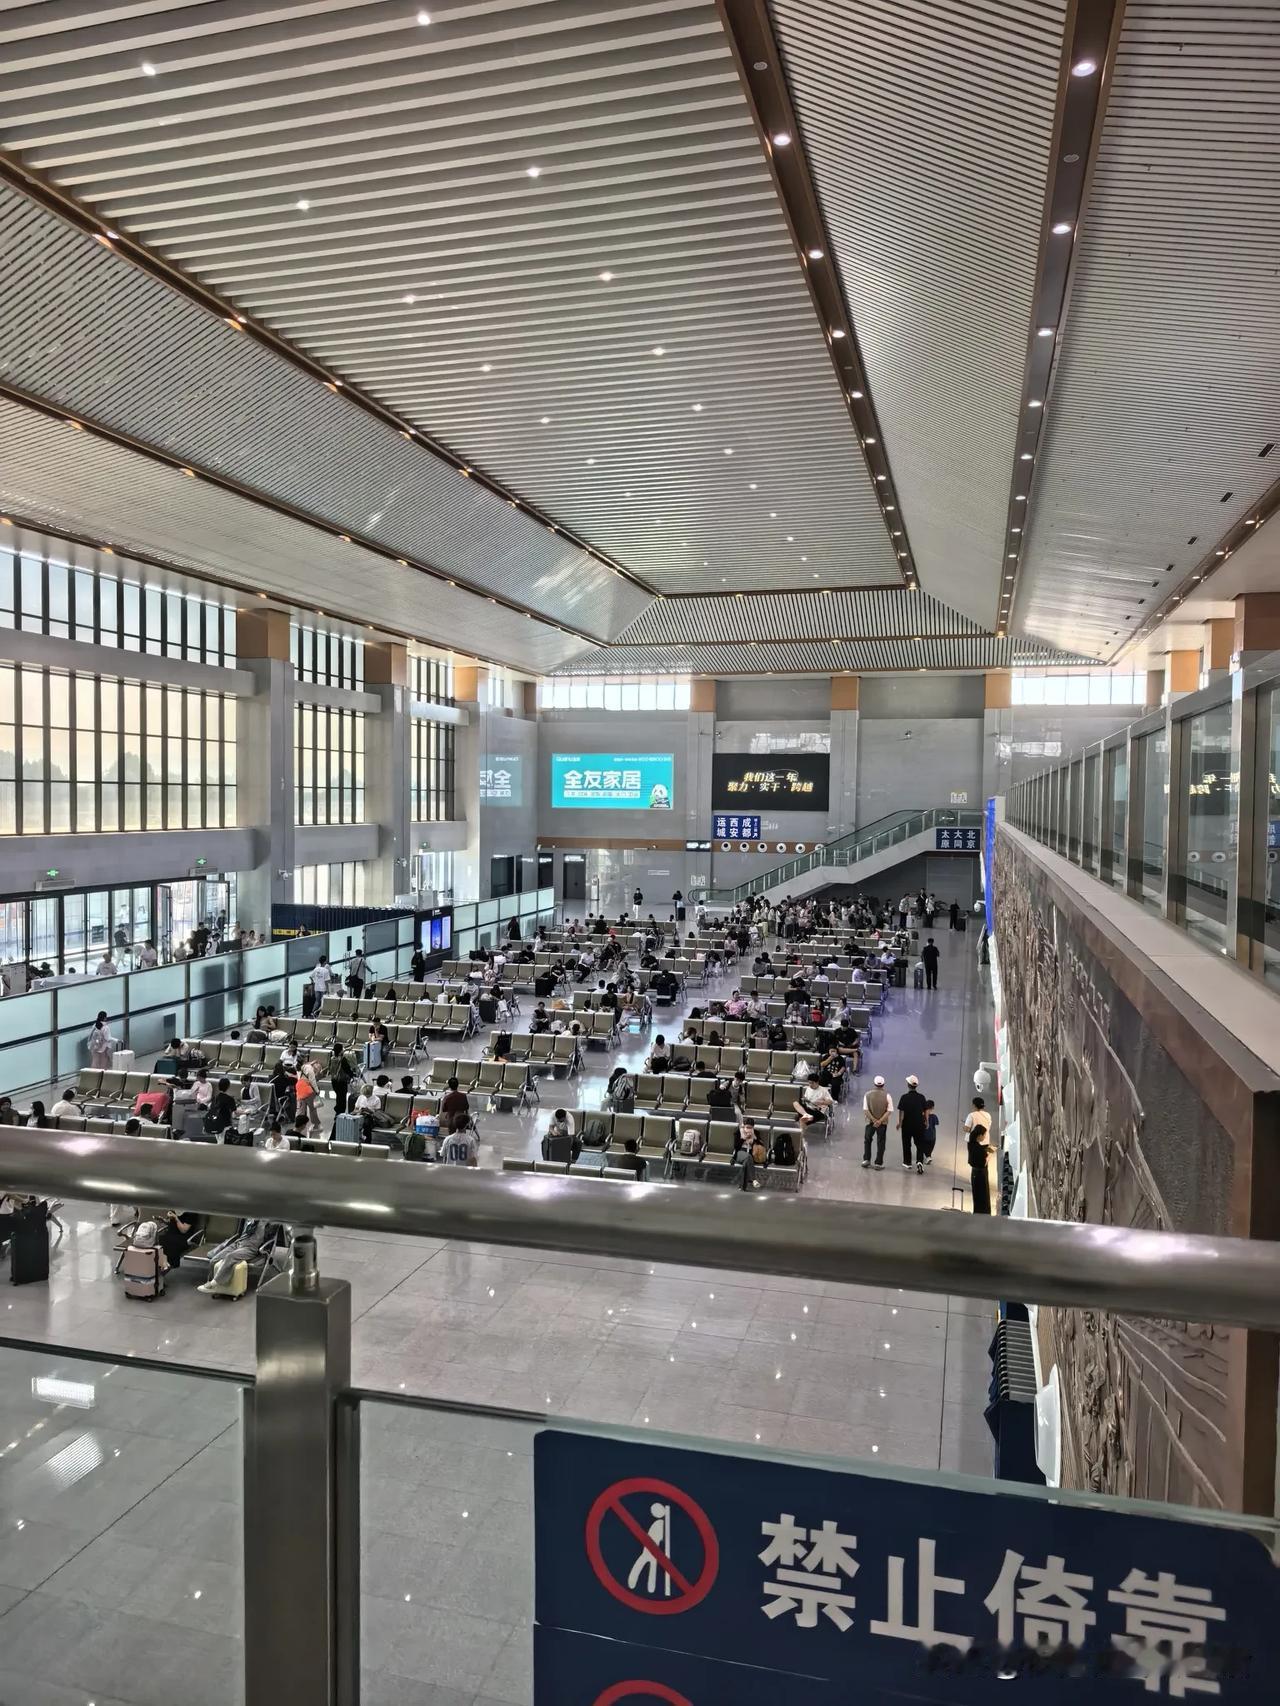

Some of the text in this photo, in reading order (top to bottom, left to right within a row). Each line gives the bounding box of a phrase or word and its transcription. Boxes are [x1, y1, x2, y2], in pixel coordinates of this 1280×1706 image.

[563, 769, 641, 789] 全友家居
[743, 772, 799, 783] 我们这一年
[450, 1144, 468, 1161] 08
[757, 1512, 1227, 1698] 禁止倚靠
